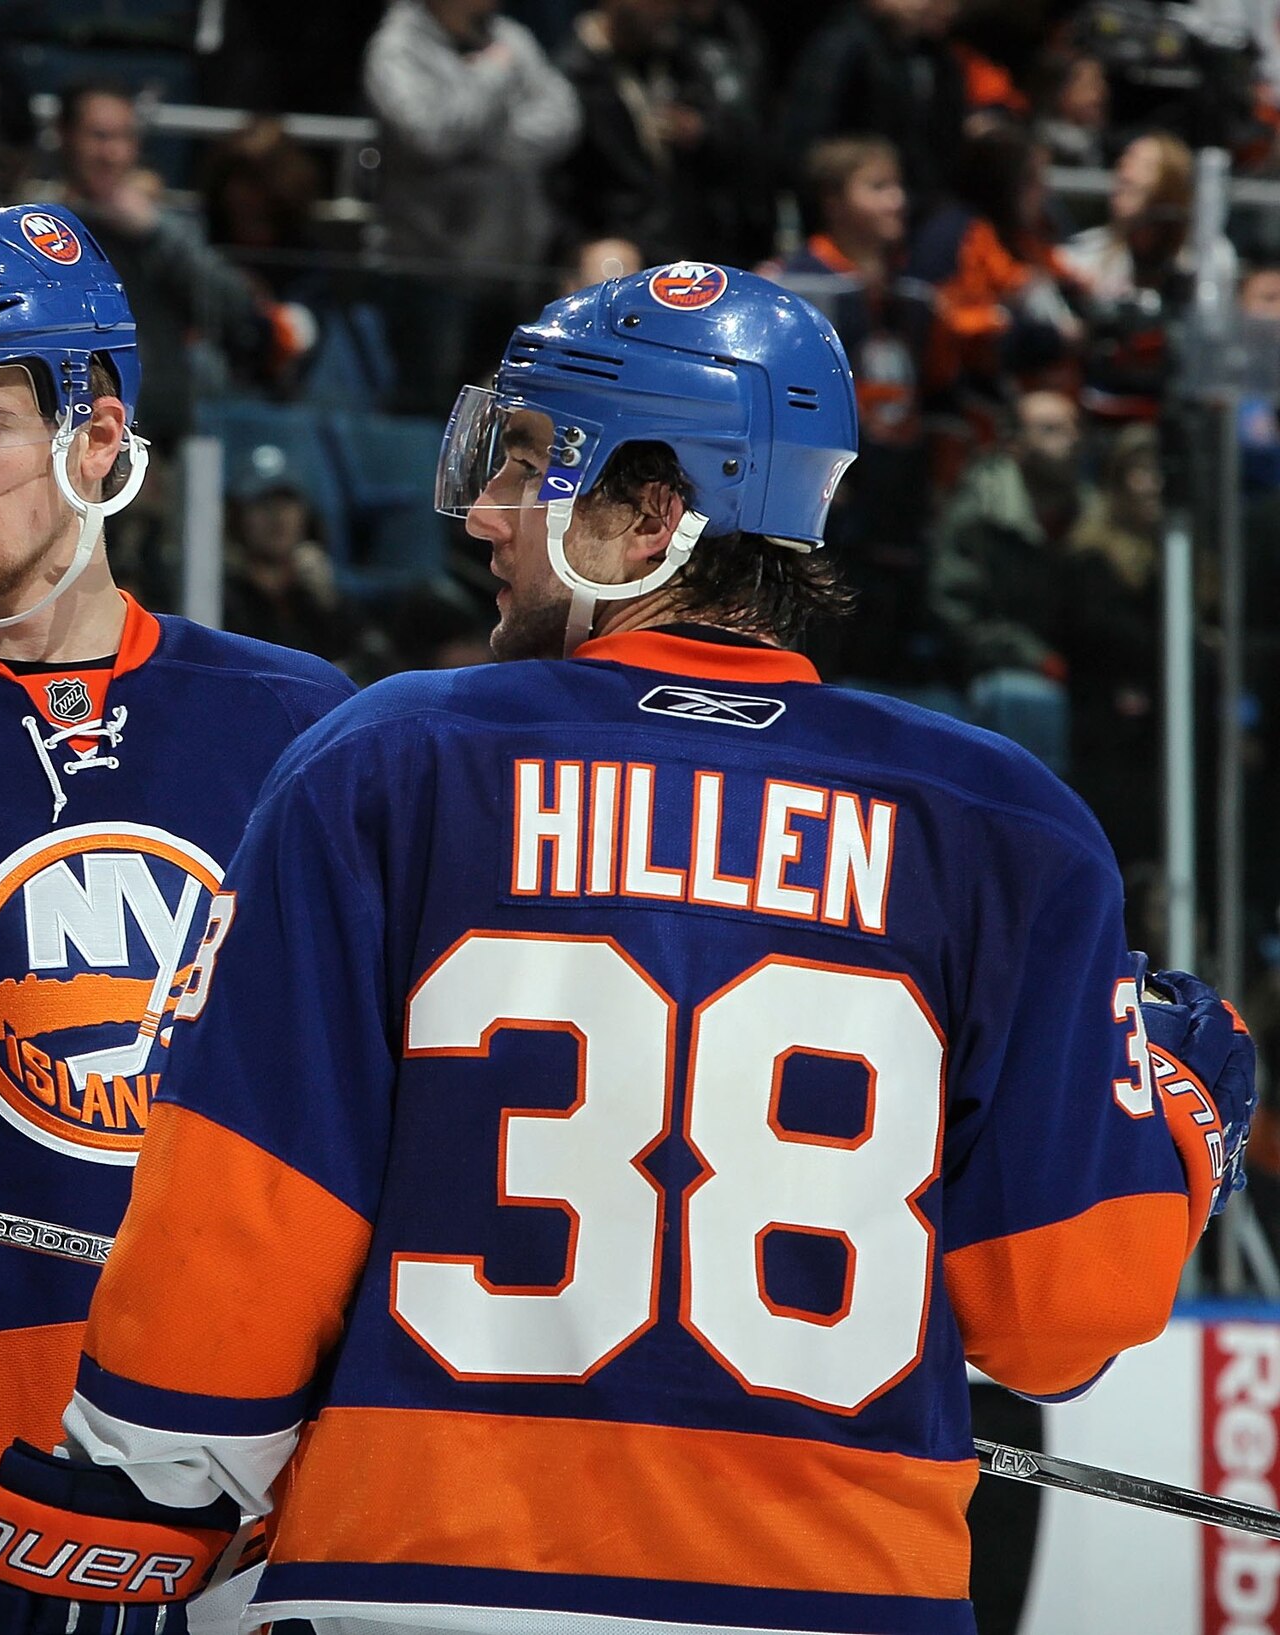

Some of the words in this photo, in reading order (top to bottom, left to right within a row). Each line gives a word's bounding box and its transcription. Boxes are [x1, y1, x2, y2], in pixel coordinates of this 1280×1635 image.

[58, 689, 83, 714] NHL
[510, 758, 899, 936] HILLEN
[23, 853, 203, 985] NY
[4, 1034, 162, 1130] ISLAN
[1110, 977, 1154, 1120] 3
[389, 928, 948, 1417] 38
